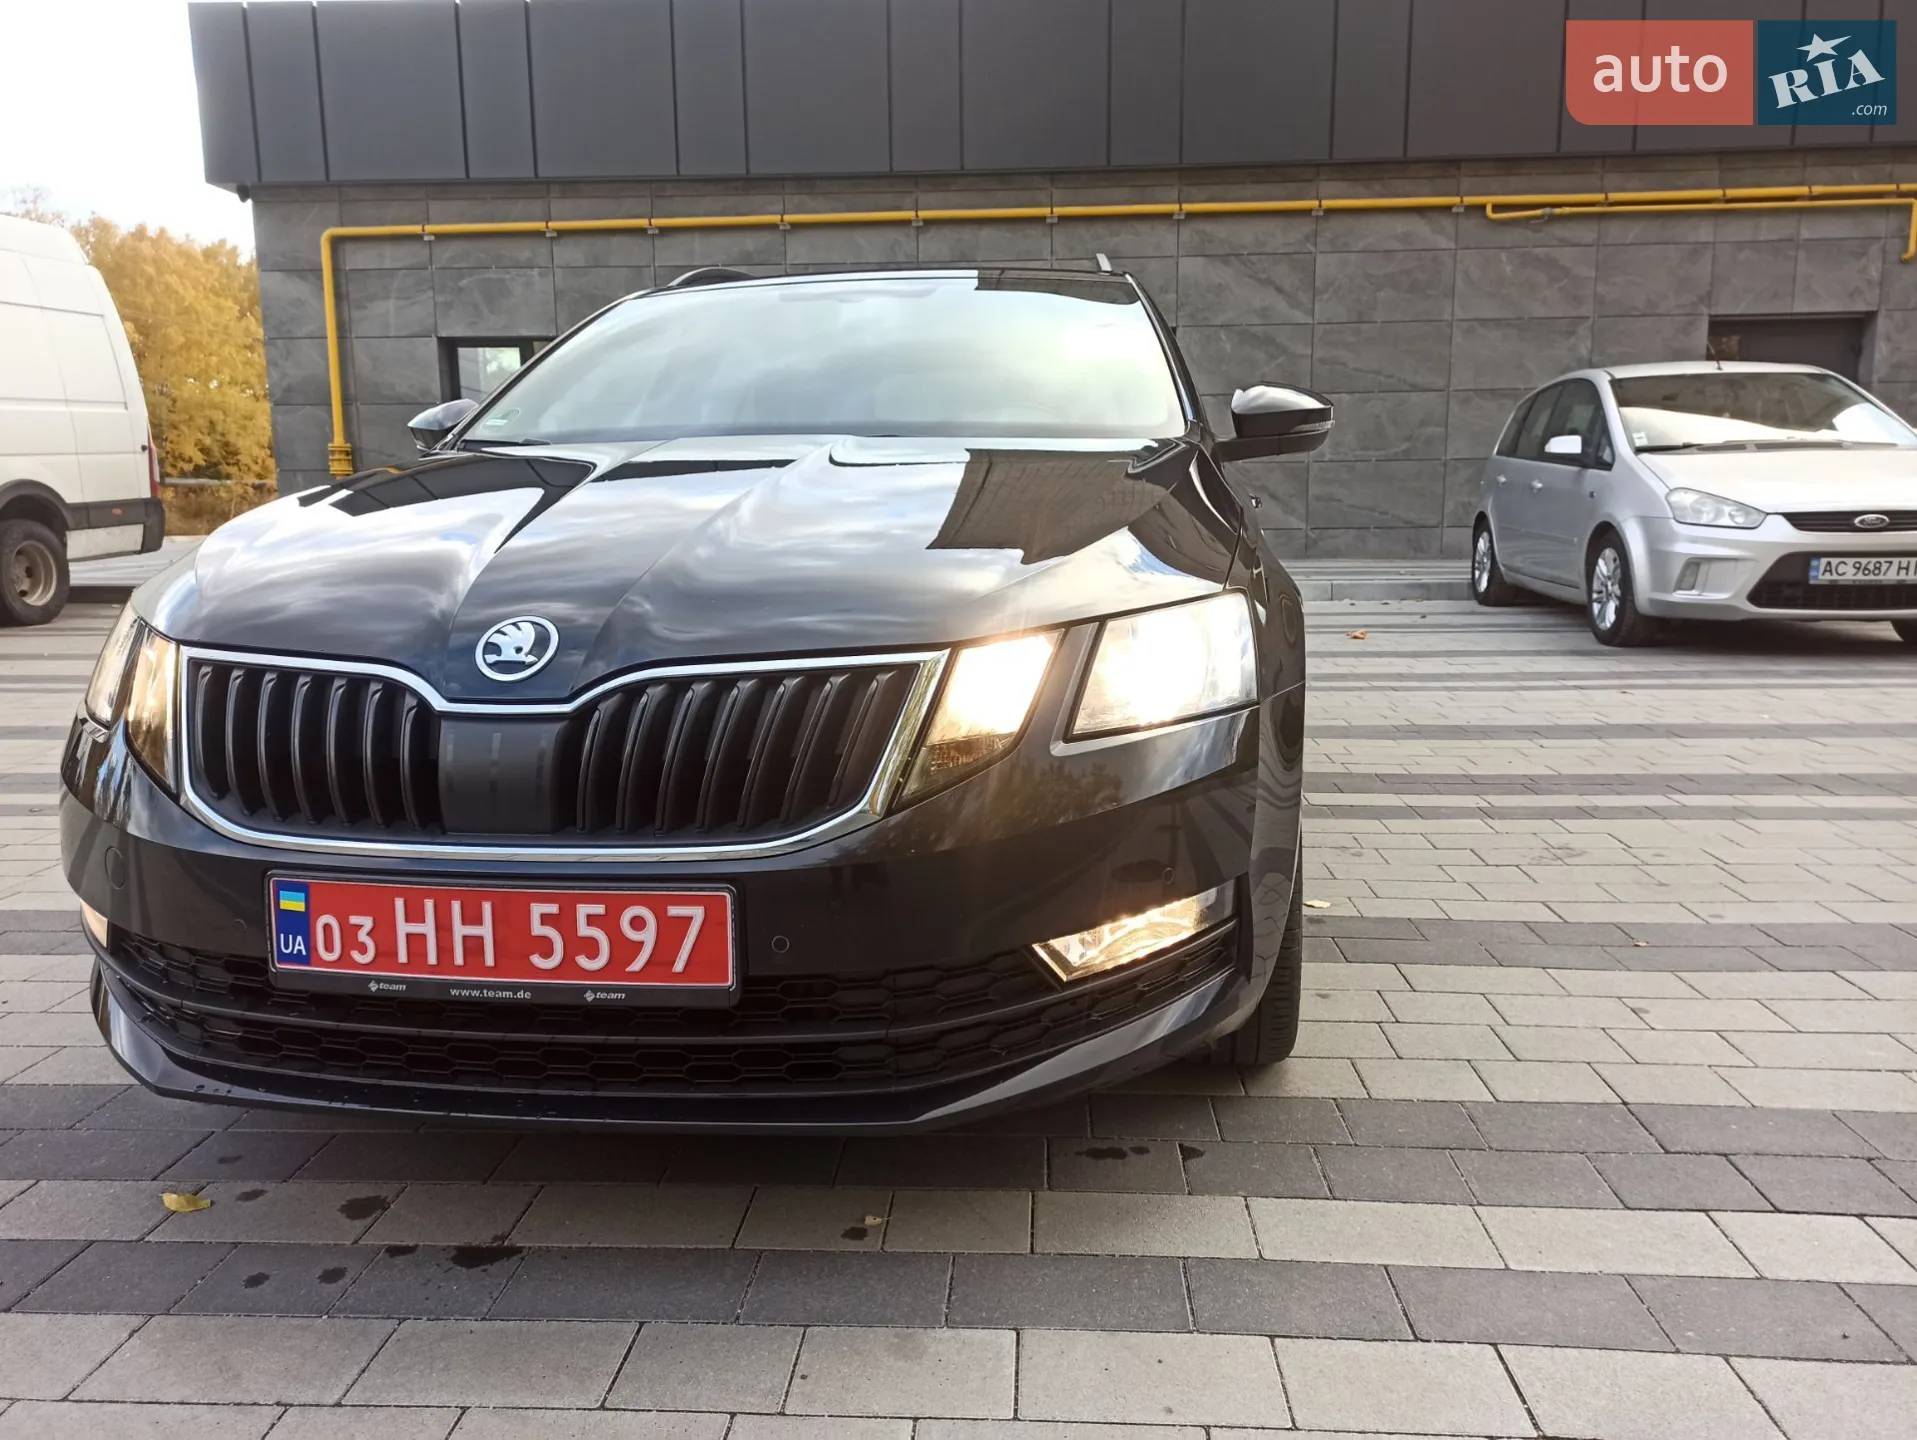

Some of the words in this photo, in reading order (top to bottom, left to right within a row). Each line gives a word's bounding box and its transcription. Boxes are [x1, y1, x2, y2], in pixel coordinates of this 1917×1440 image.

[1821, 560, 1848, 577] AC
[1852, 560, 1893, 577] 9687
[1896, 560, 1917, 577] H
[279, 933, 307, 956] UA
[315, 914, 376, 965] 03
[394, 897, 495, 968] HH
[529, 902, 706, 973] 5597
[379, 982, 407, 992] team
[450, 988, 532, 1000] www.team.de
[596, 990, 626, 1000] team
